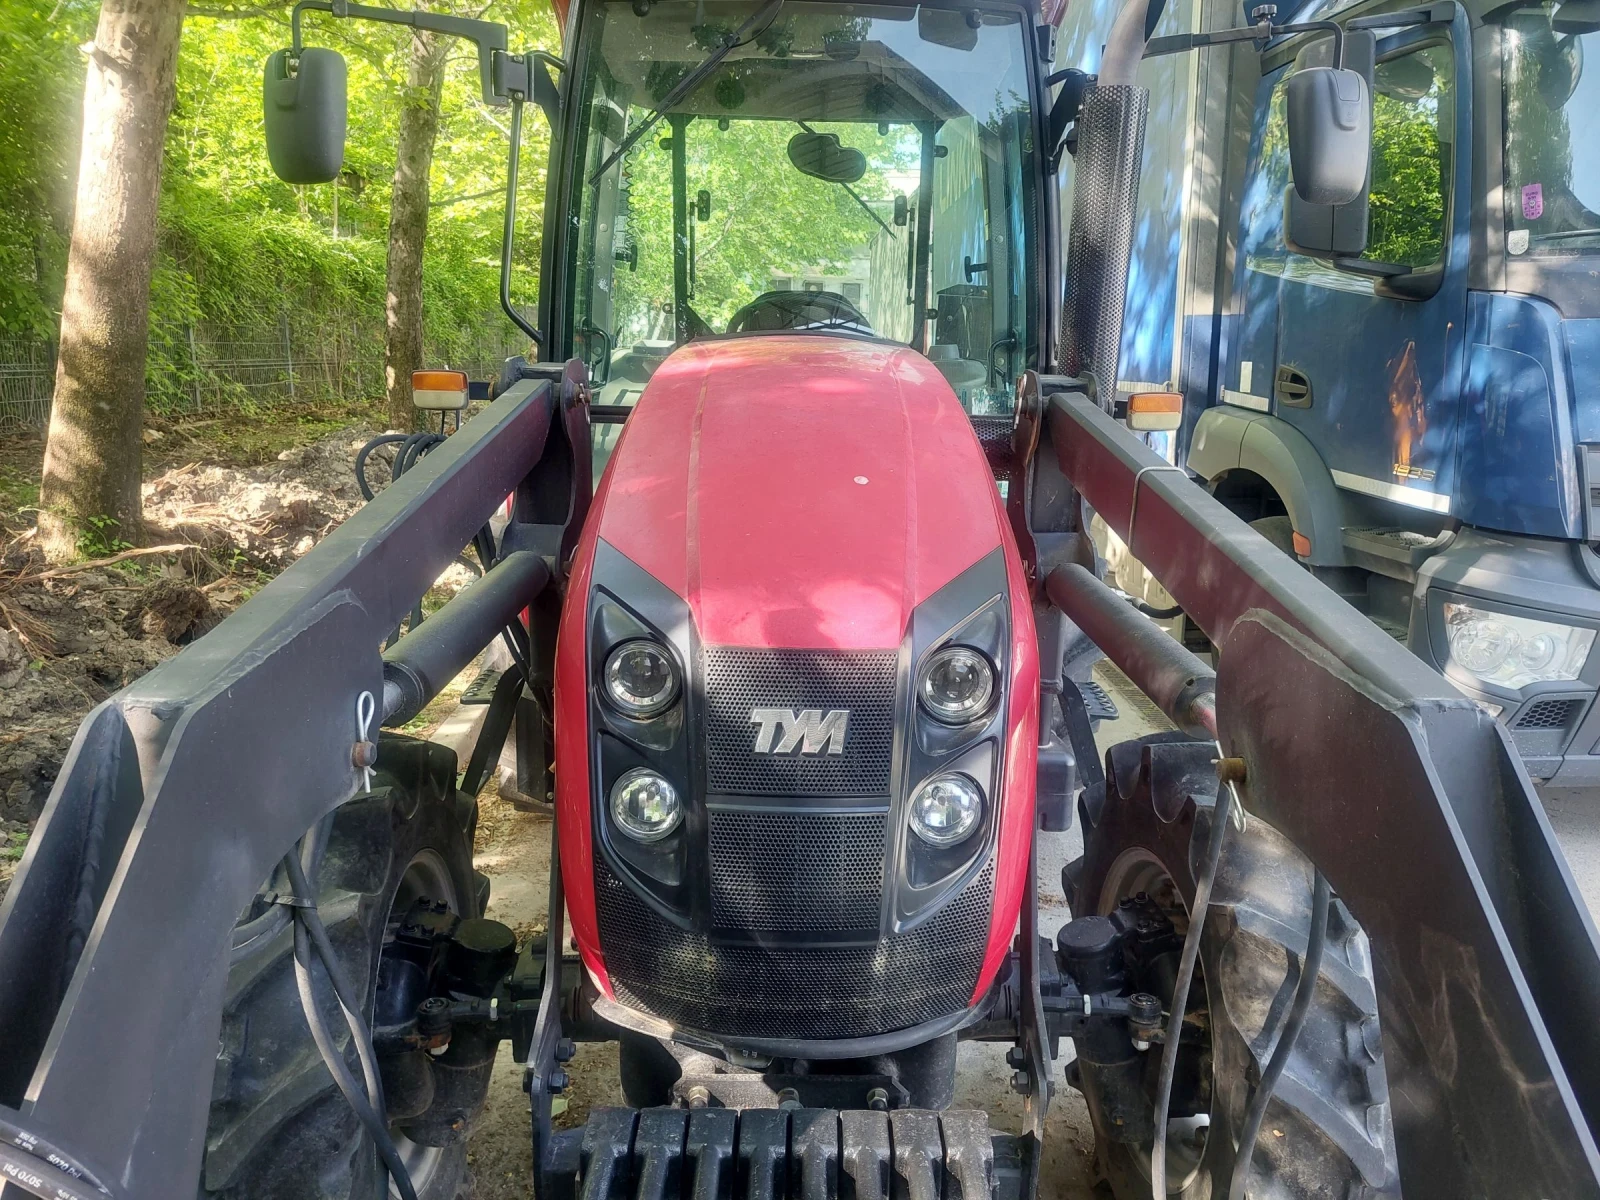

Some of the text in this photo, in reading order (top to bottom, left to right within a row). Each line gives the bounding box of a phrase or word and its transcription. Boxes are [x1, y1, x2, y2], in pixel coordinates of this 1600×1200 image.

[750, 708, 850, 755] TYM
[46, 1153, 69, 1171] 5070
[17, 1171, 43, 1188] 5070
